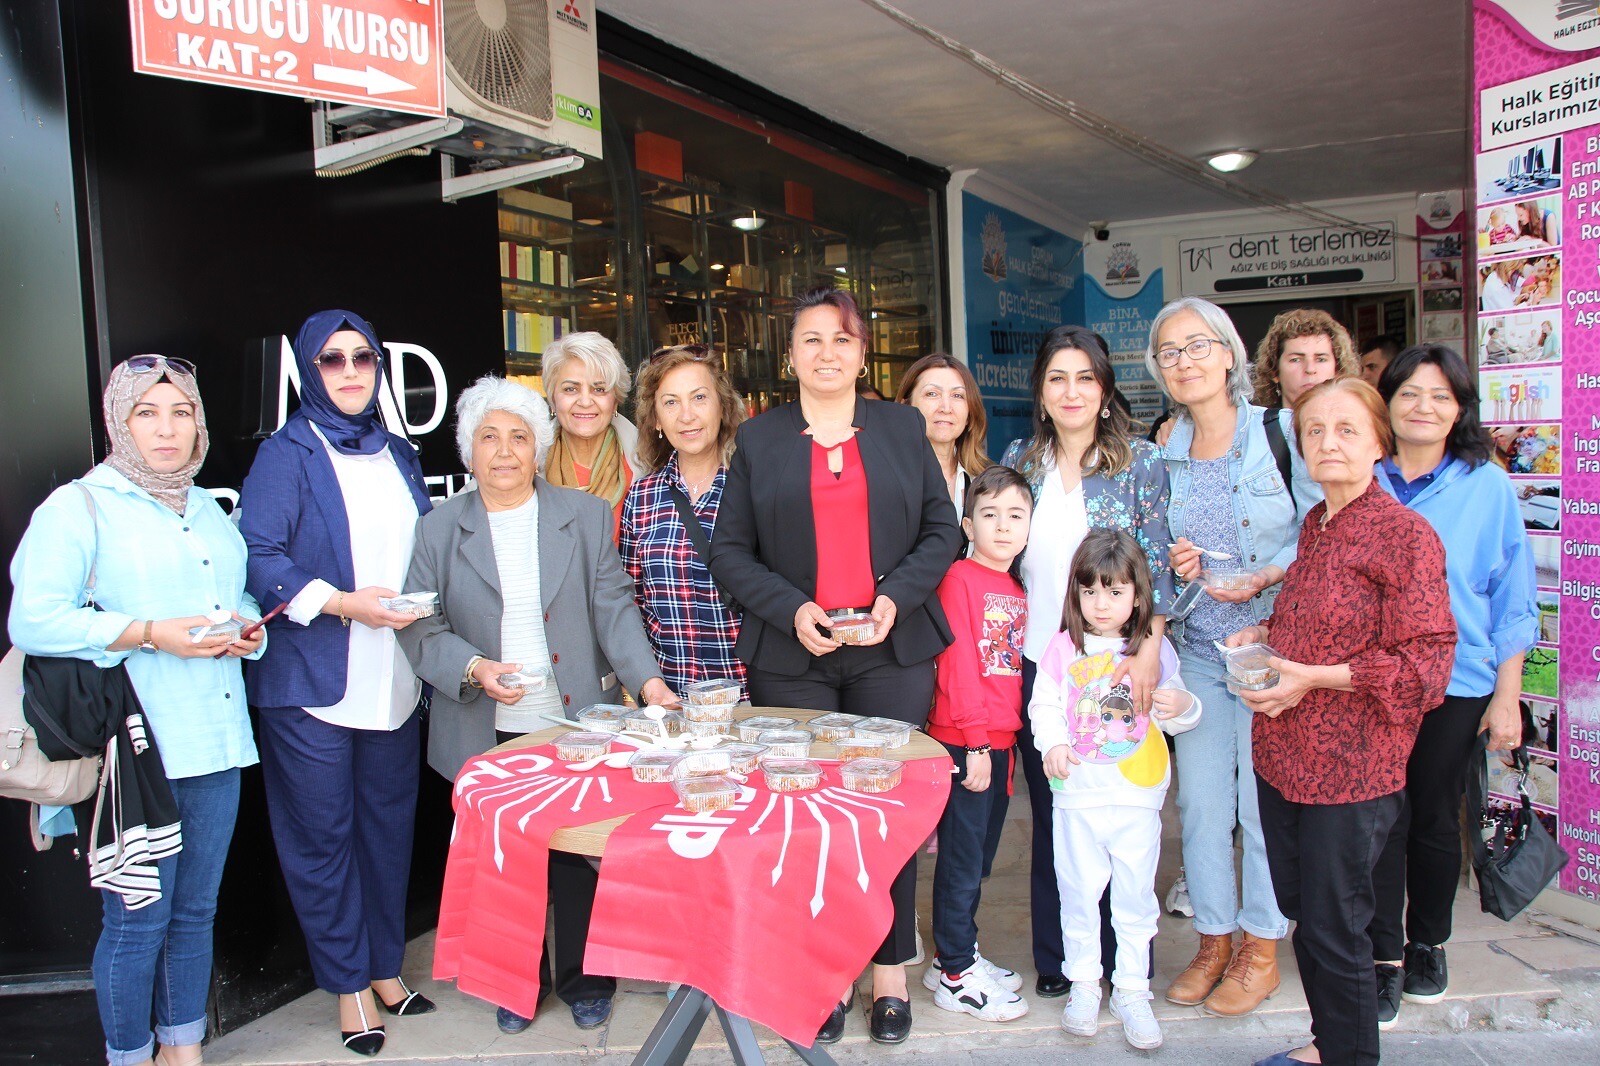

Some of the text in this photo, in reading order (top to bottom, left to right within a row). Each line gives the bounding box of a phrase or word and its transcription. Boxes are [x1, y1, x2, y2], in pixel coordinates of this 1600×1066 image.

[322, 4, 430, 65] KURSU
[177, 33, 299, 82] KAT:2
[1502, 90, 1543, 112] Halk
[1568, 182, 1588, 200] AB
[1577, 203, 1587, 220] F
[1229, 229, 1391, 259] dent terlemez
[1257, 263, 1269, 271] VE
[1092, 322, 1115, 334] KAT
[976, 354, 1029, 390] ücretsiz
